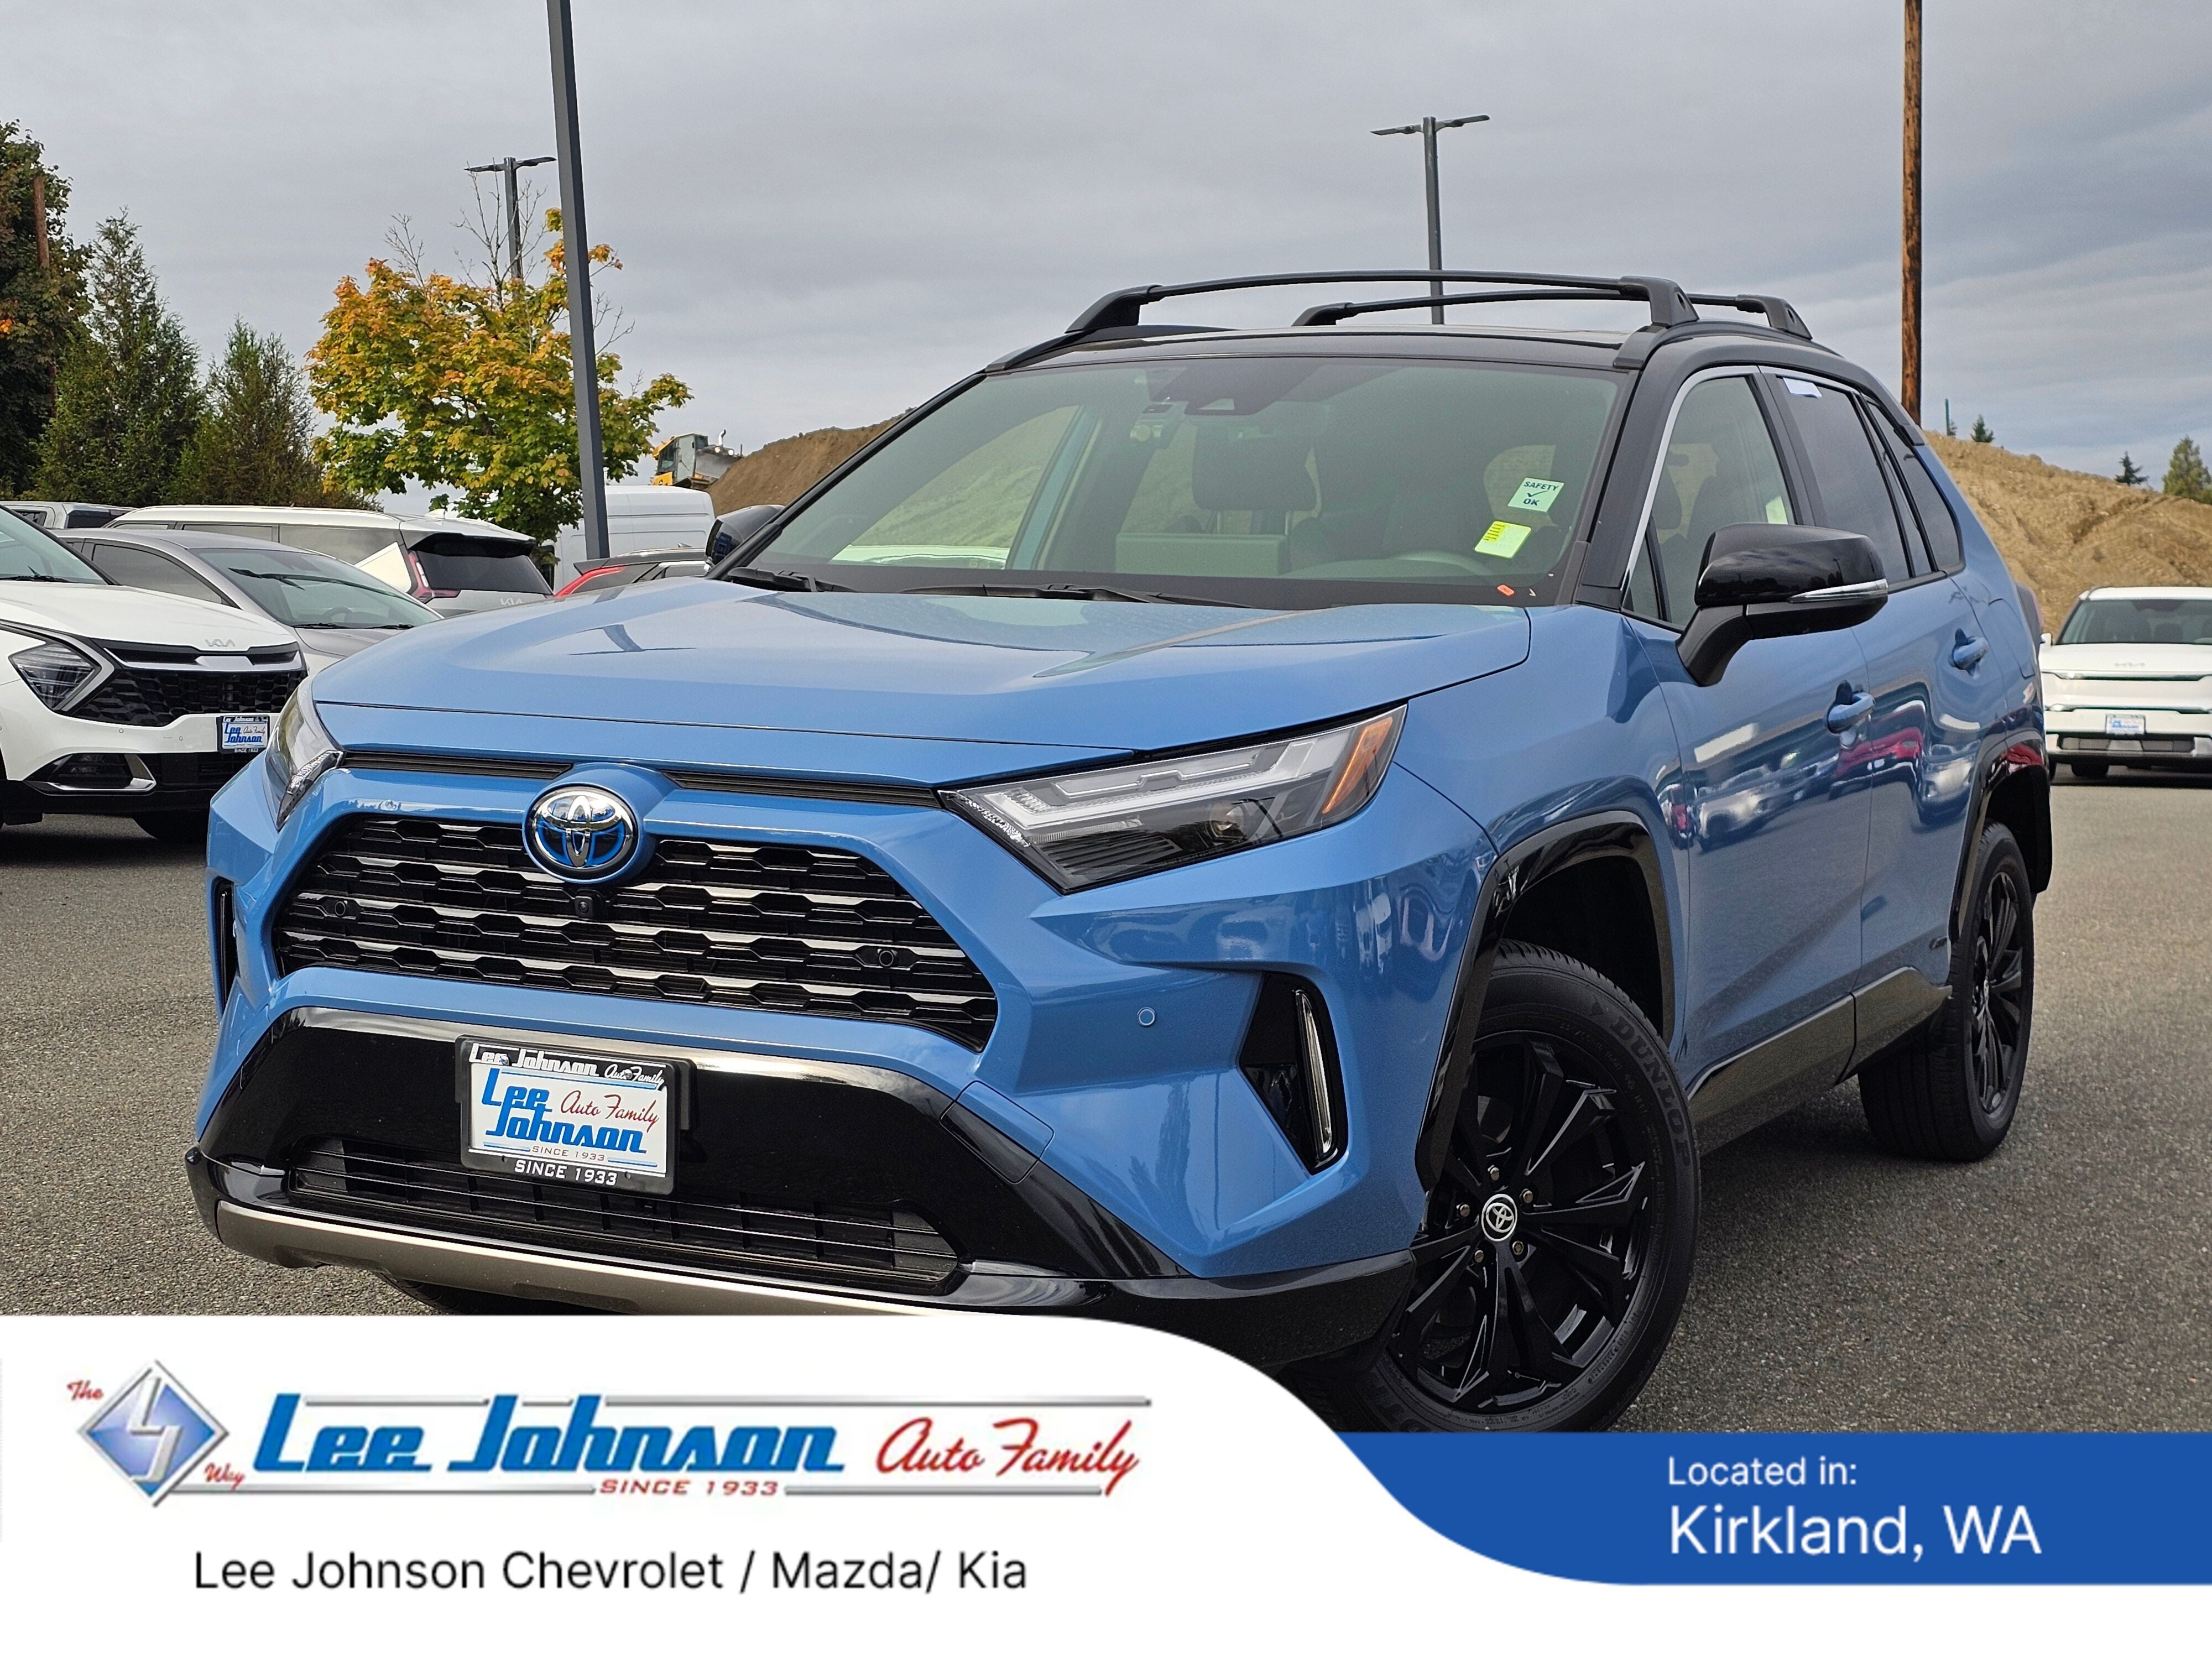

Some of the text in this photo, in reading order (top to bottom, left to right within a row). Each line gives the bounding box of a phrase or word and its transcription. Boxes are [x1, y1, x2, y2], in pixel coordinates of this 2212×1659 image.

[1524, 481, 1559, 491] SAFETY
[500, 597, 523, 606] KIA
[225, 722, 241, 734] Lee
[225, 733, 263, 743] Johnson
[512, 1048, 600, 1076] Johnson
[630, 1066, 665, 1091] Family
[482, 1068, 659, 1133] Lee Auto Family
[1609, 1016, 1692, 1167] DUNLOP
[486, 1102, 647, 1154] Johnson
[532, 1145, 605, 1161] SINCE 1933
[514, 1159, 618, 1186] SINCE 1933
